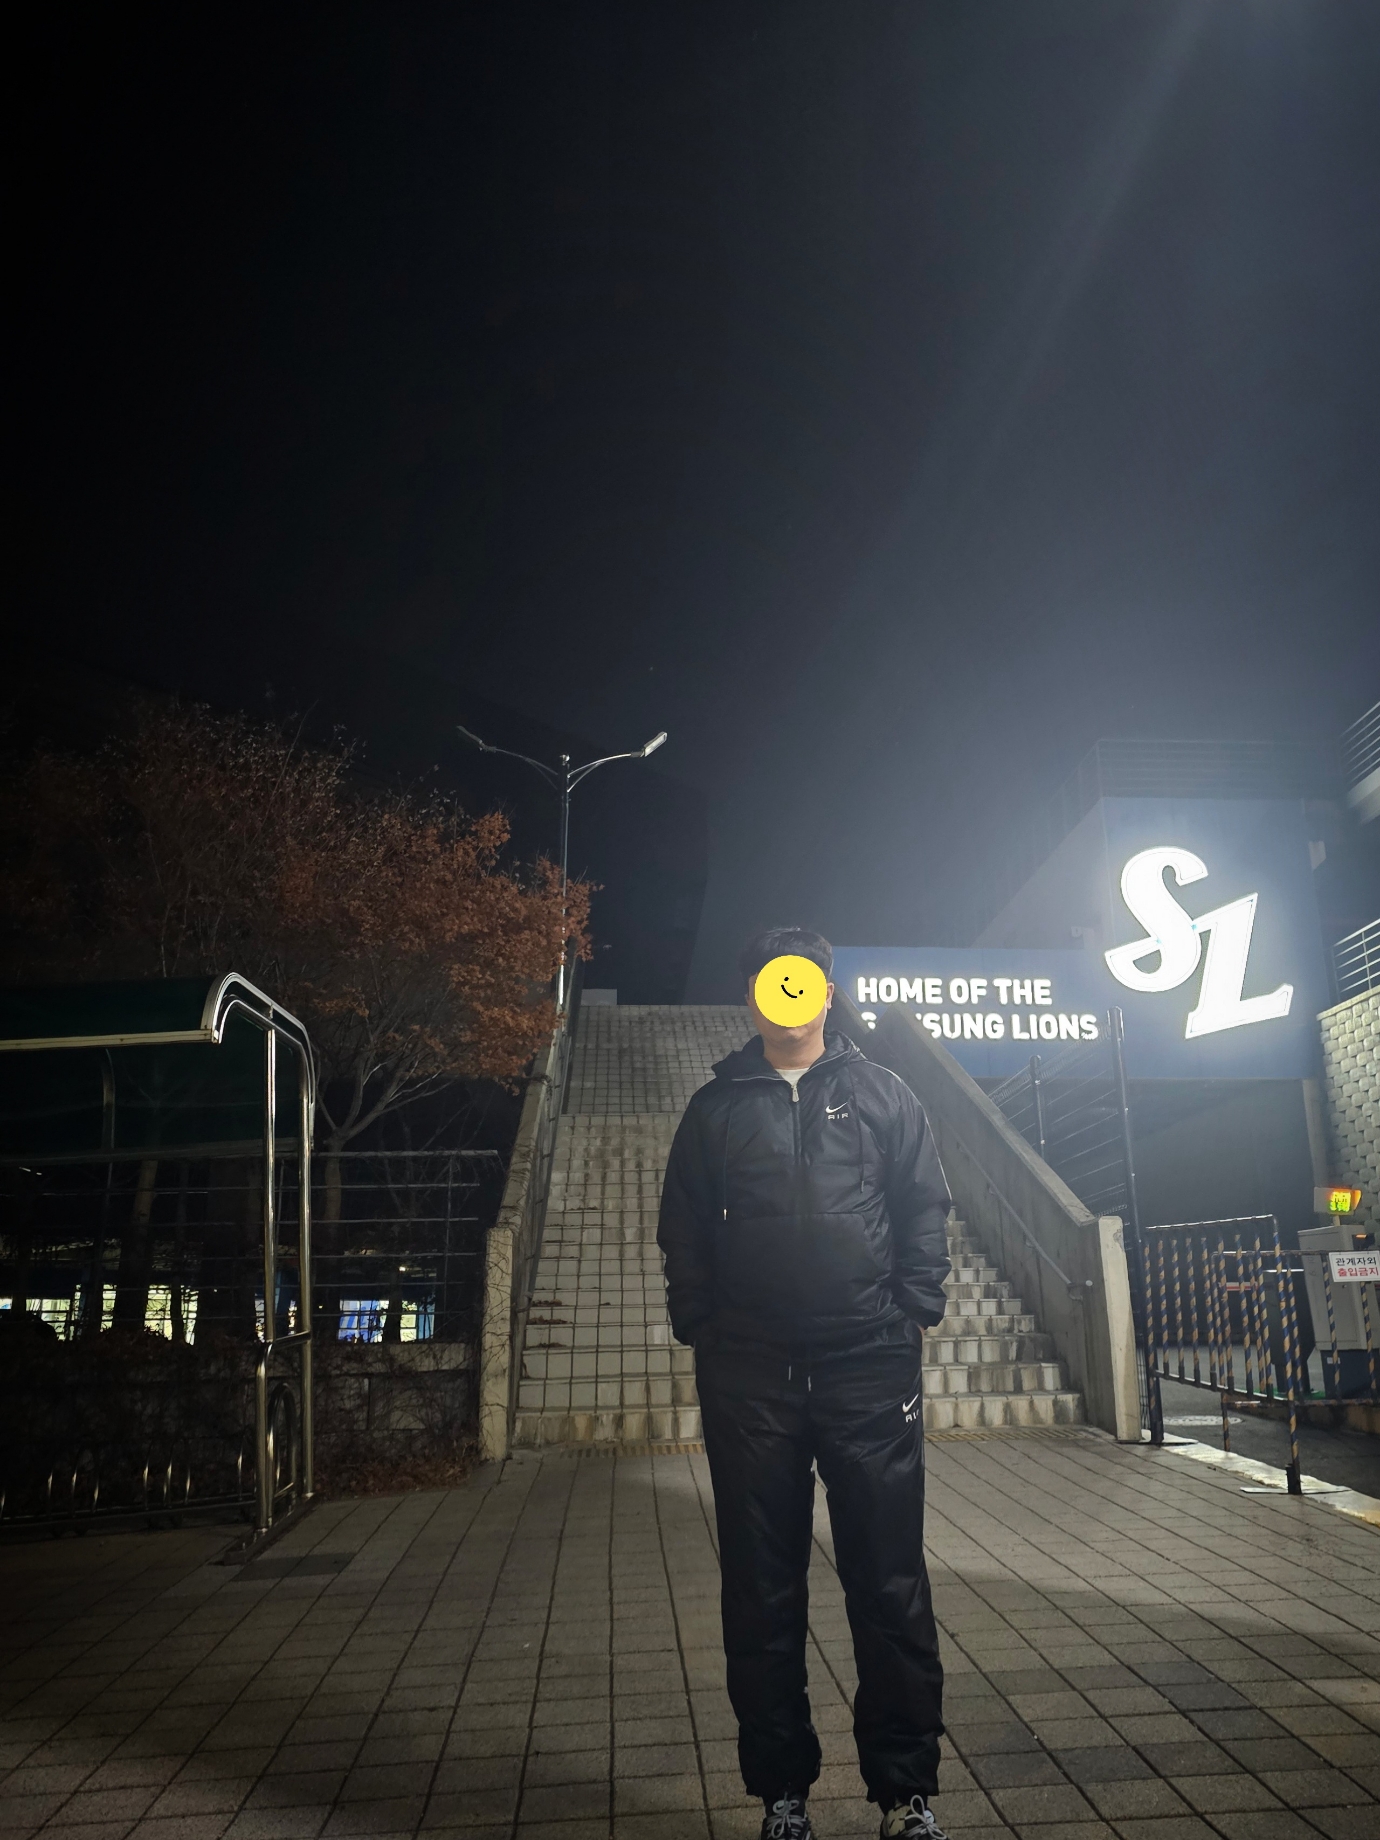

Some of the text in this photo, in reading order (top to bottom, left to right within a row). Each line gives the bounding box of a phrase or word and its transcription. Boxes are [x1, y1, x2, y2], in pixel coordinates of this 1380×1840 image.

[1104, 844, 1294, 1040] SL
[857, 976, 1053, 1005] HOME OF THE
[860, 1011, 1099, 1040] SSUNG LIONS
[1335, 1256, 1376, 1266] 관계자외
[1337, 1266, 1379, 1277] 출입금지
